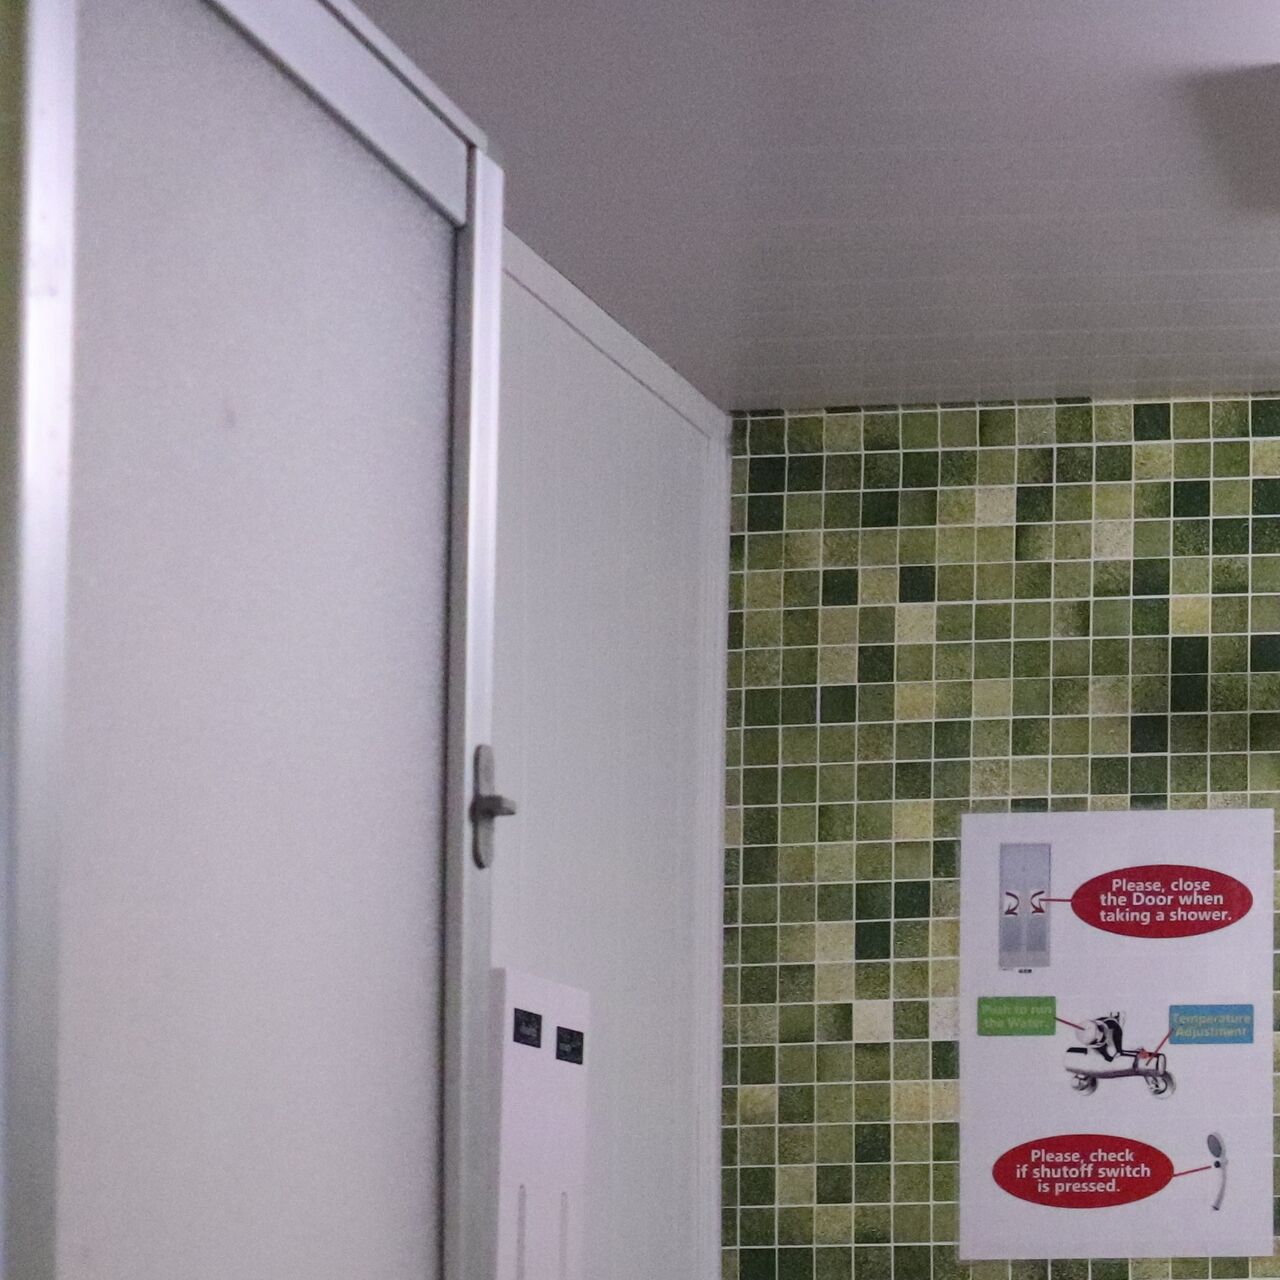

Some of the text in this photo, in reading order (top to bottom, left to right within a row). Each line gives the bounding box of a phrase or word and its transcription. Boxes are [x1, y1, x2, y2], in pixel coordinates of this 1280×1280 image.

[1112, 878, 1211, 893] Please, close
[1100, 891, 1224, 906] the Door when
[1100, 908, 1232, 926] taking a shower.
[1171, 1013, 1250, 1026] Temperature
[1175, 1027, 1248, 1038] Adjustment
[1031, 1149, 1134, 1165] Please, check
[1016, 1163, 1151, 1179] if shutoff switch
[1038, 1179, 1121, 1196] is pressed.
